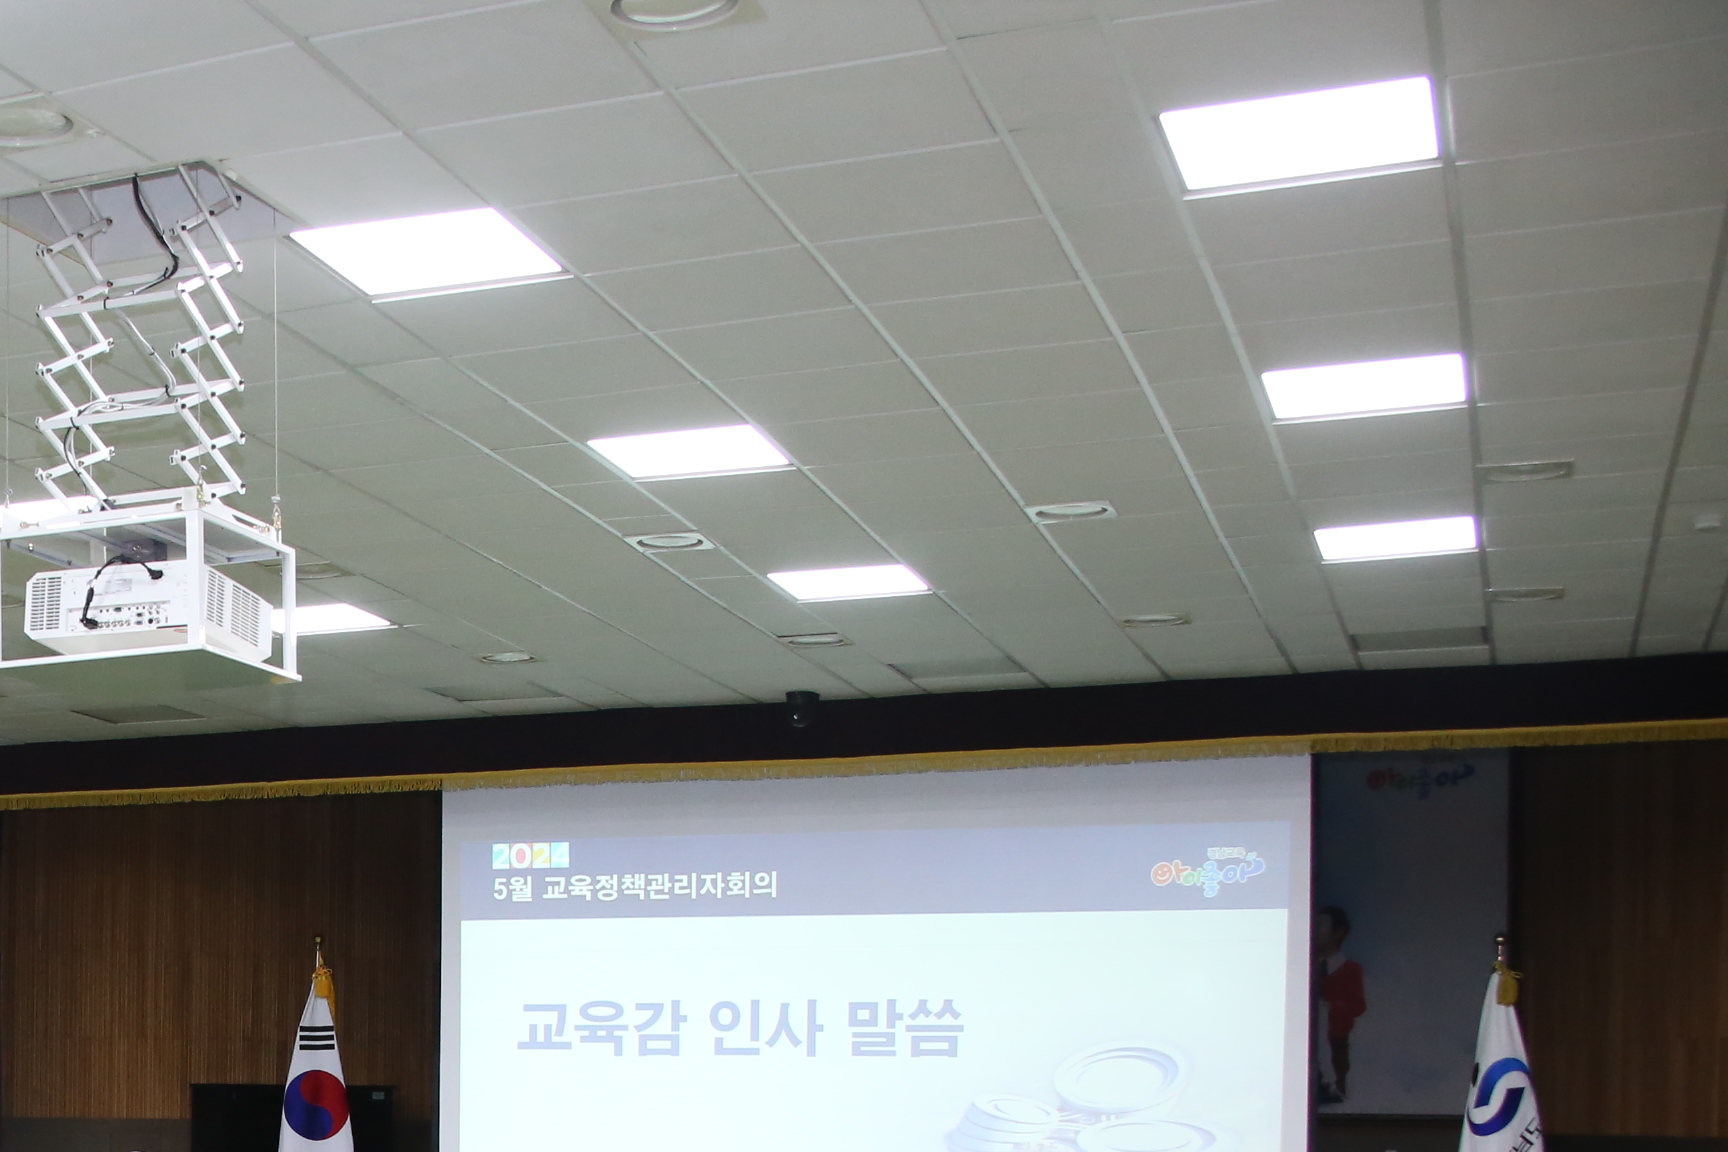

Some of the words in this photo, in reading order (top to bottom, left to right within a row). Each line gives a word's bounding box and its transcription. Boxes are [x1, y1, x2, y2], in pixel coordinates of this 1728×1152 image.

[492, 842, 570, 869] 2024
[492, 875, 533, 902] 5월
[541, 870, 778, 901] 교육정책관리자회의
[1151, 858, 1266, 898] 아이좋아
[516, 999, 688, 1057] 교육감
[708, 998, 825, 1058] 인사
[847, 998, 965, 1058] 말씀
